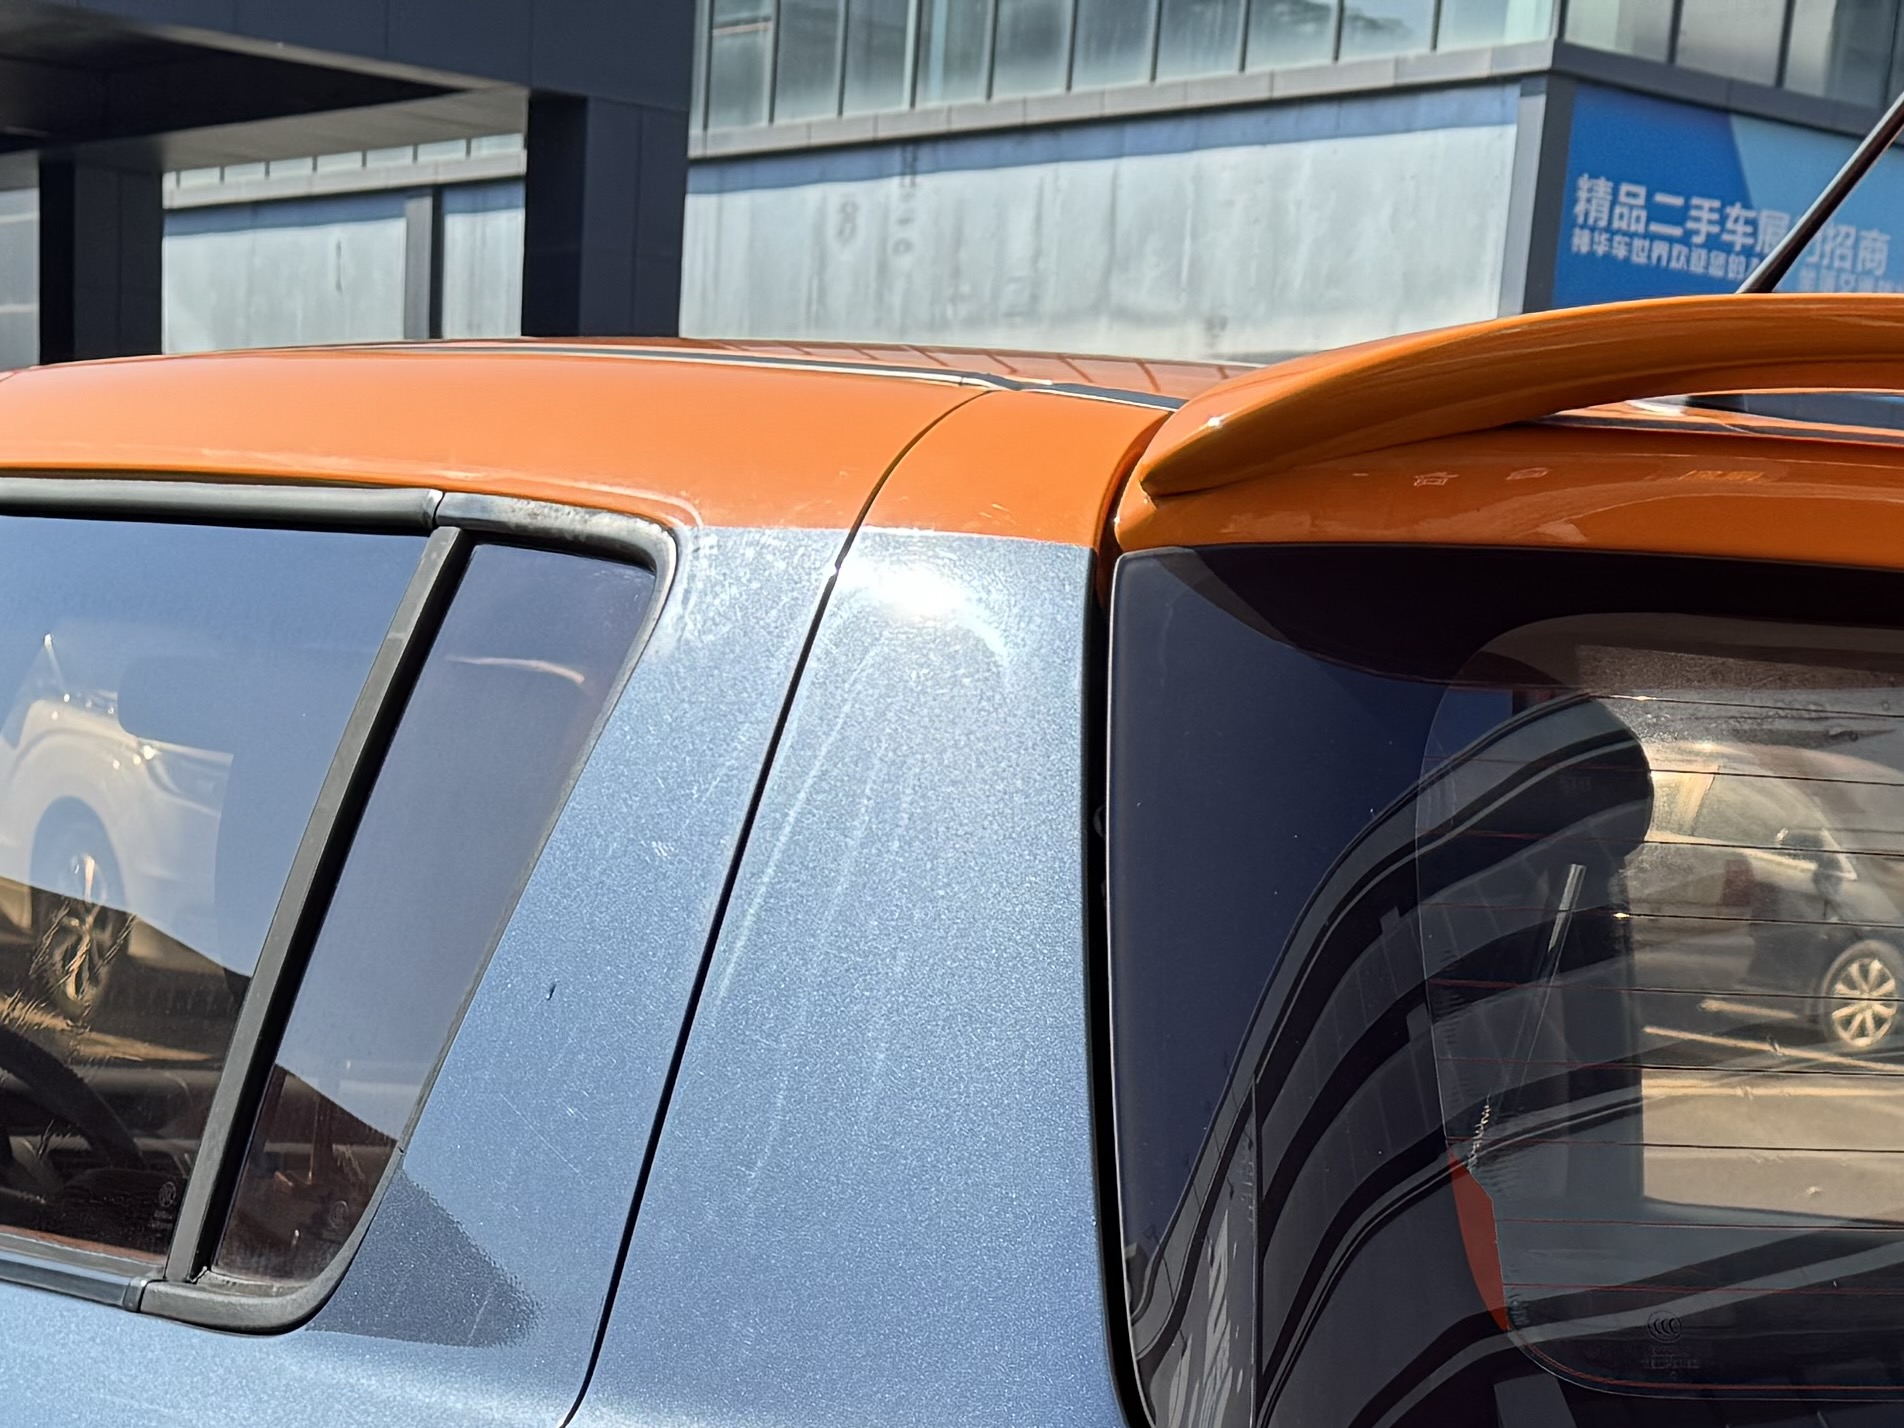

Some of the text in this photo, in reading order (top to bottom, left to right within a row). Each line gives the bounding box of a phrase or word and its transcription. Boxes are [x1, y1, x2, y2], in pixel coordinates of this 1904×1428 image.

[1573, 172, 1892, 278] 精品二手车展招商
